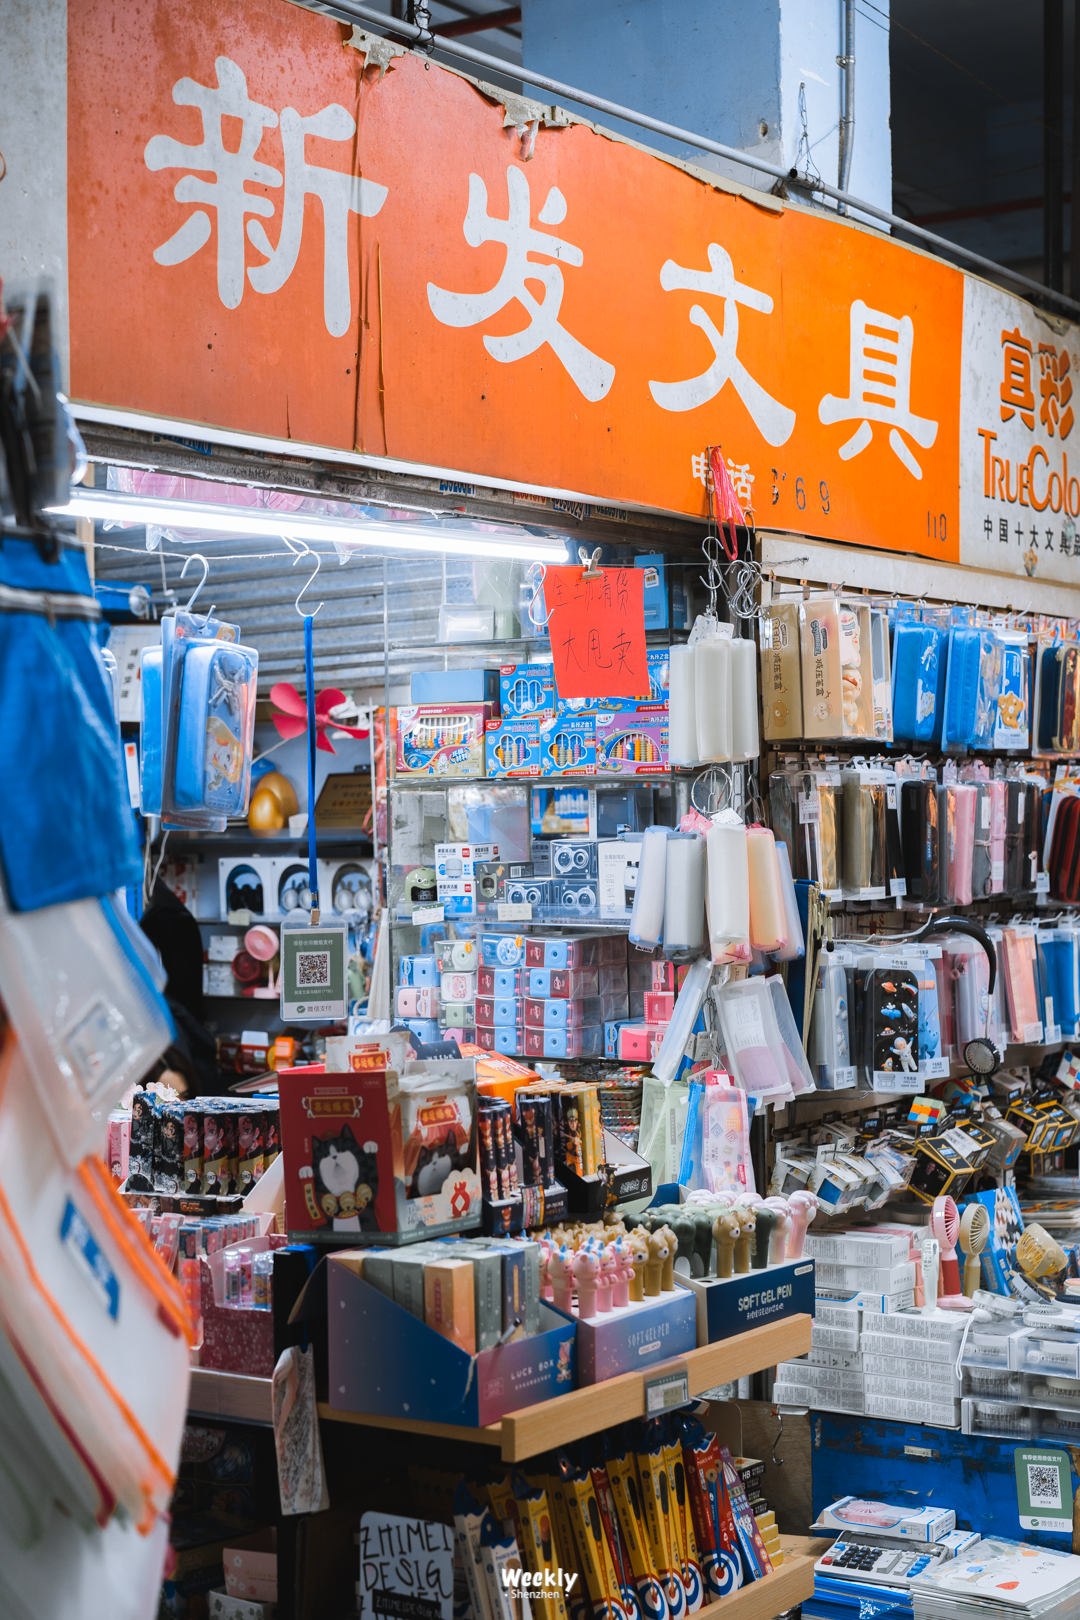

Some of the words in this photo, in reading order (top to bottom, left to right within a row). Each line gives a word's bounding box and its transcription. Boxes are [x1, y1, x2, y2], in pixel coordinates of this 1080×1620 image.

[143, 56, 939, 481] 新发文具
[738, 1293, 760, 1311] SOFT
[761, 1289, 776, 1304] GEL
[777, 1283, 792, 1300] PEN
[511, 1366, 533, 1380] LUCK
[538, 1359, 554, 1372] BOX
[742, 1470, 751, 1480] HB
[1041, 1520, 1065, 1529] 微信支付
[360, 1521, 452, 1560] ZHIMEI
